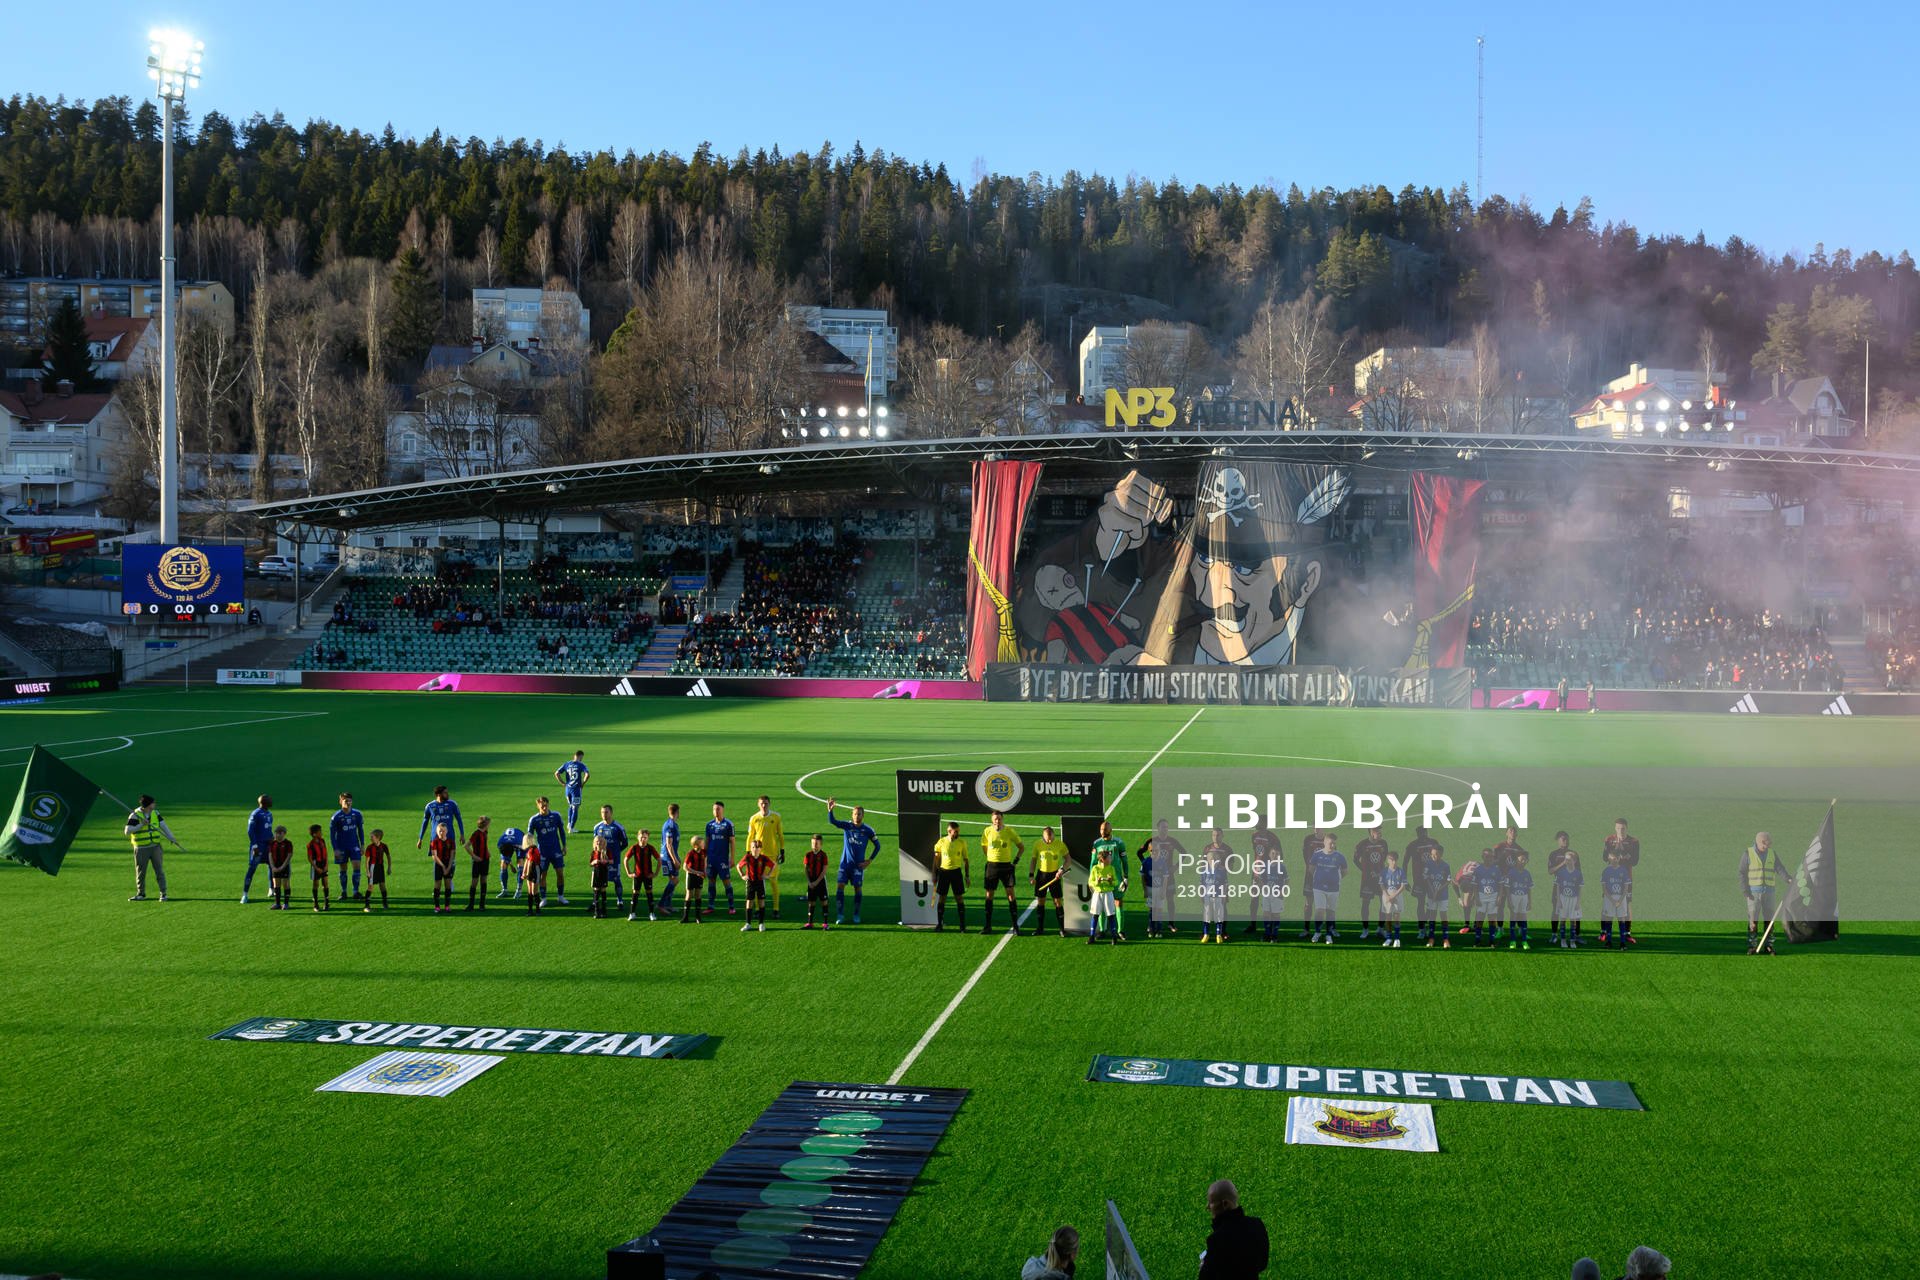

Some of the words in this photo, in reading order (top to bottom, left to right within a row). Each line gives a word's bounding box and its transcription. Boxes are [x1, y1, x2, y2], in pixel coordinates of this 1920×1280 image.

[1105, 387, 1177, 427] NP3
[150, 604, 159, 614] 0
[210, 604, 219, 614] 0
[233, 670, 268, 679] PEAB
[14, 682, 51, 694] UNIBET
[1020, 668, 1056, 698] BYE
[1060, 671, 1092, 699] BYE
[1098, 668, 1139, 699] ÖFK!
[1143, 672, 1165, 700] NU
[1170, 672, 1239, 701] STICKER
[1240, 673, 1259, 700] VI
[1264, 673, 1299, 700] MOT
[567, 767, 578, 780] 15
[907, 780, 964, 793] UNIBET
[1034, 781, 1092, 795] UNIBET
[316, 1022, 674, 1056] SUPERETTAN
[1203, 1062, 1599, 1106] SUPERETTAN
[816, 1089, 930, 1102] UNIBET
